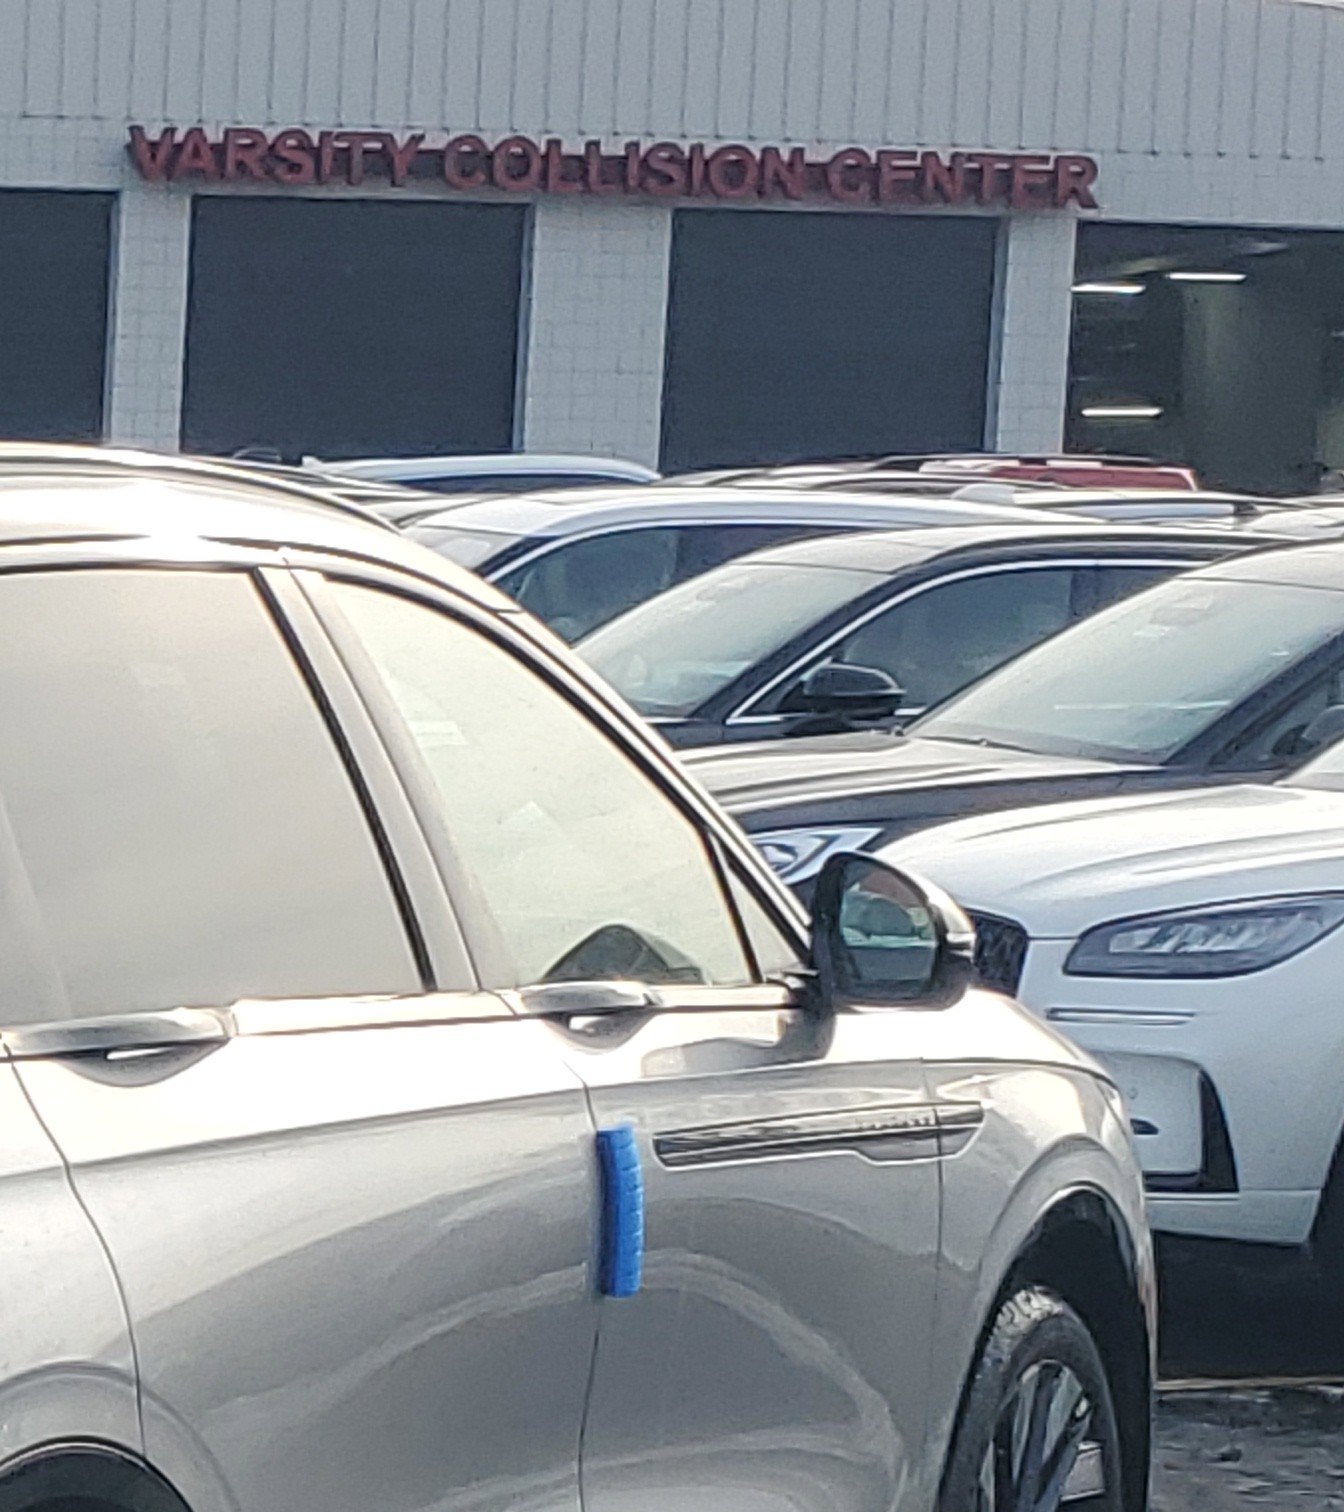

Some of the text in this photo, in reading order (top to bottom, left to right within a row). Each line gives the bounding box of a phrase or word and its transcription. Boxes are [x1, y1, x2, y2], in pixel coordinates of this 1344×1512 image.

[127, 125, 1100, 209] VARSITY COLLISION CENTER
